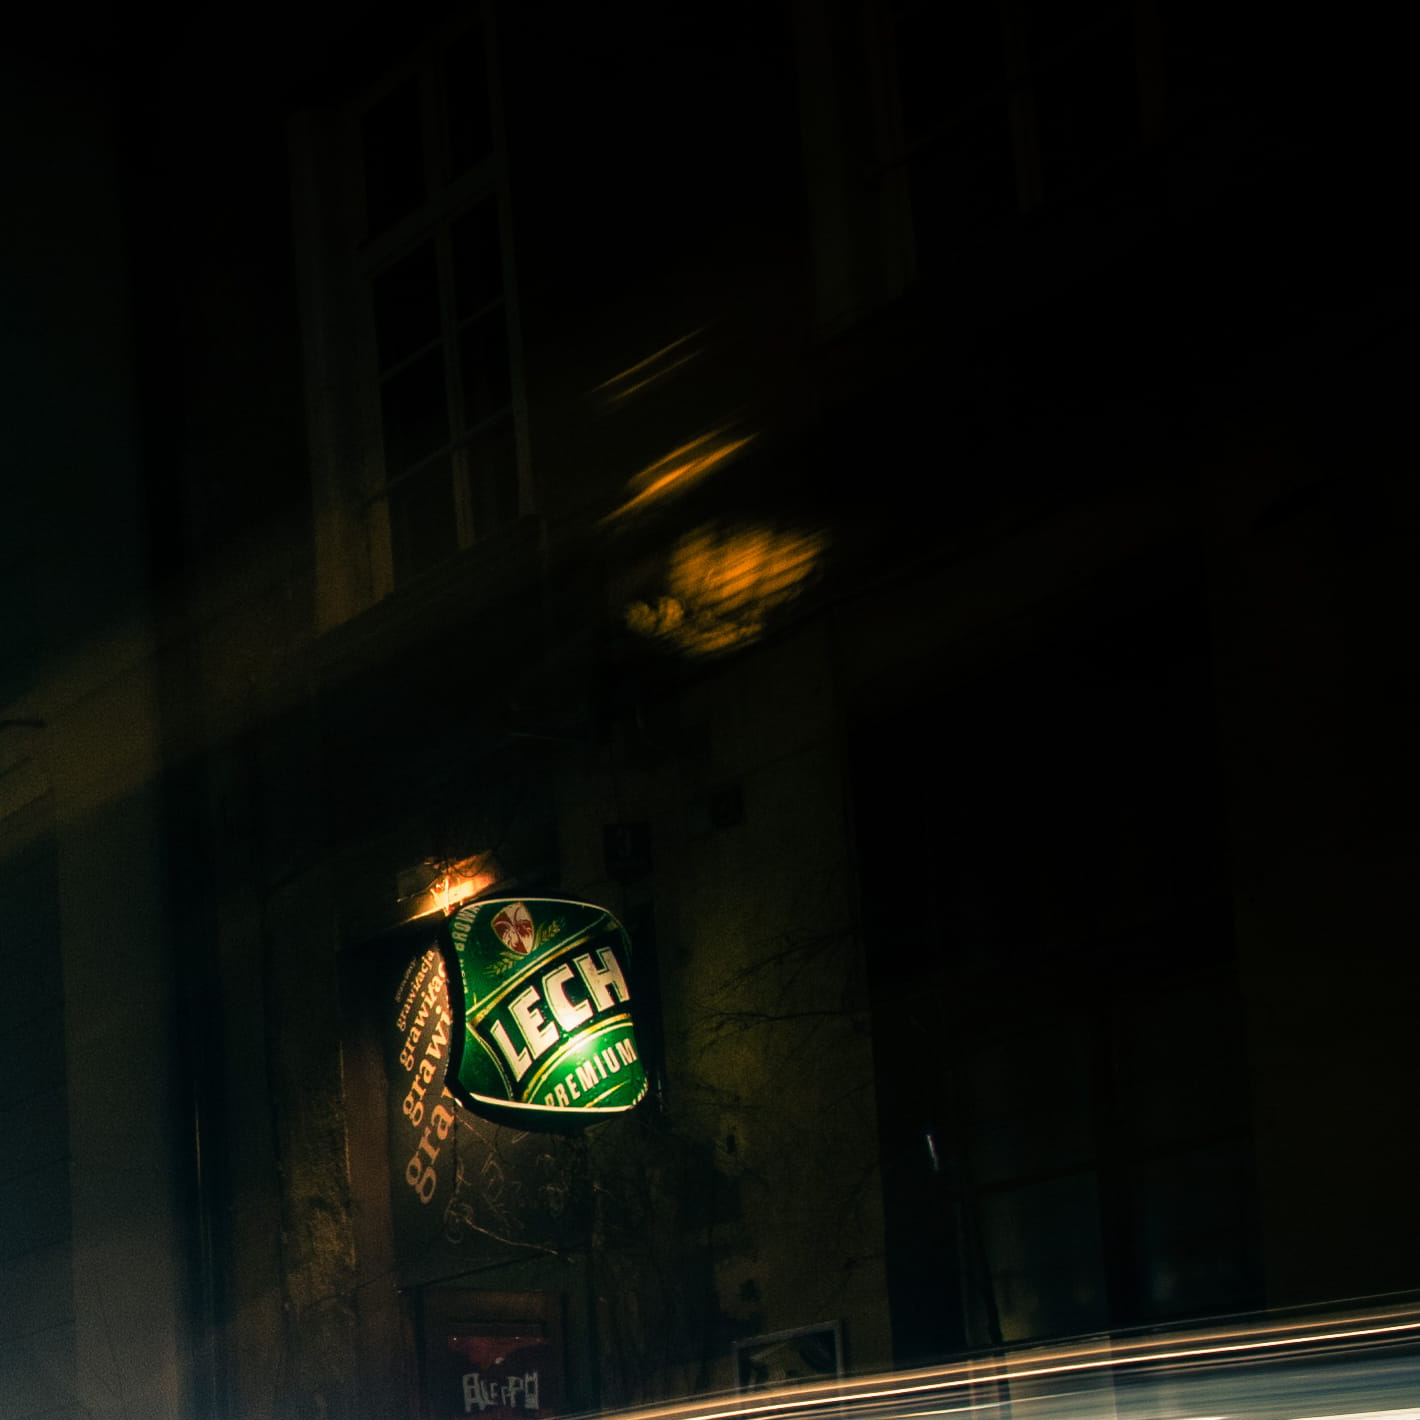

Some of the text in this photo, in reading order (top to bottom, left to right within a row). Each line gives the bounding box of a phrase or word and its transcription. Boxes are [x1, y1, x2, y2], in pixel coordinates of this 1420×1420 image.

[490, 945, 631, 1083] LECH
[544, 1037, 638, 1107] PREMIUM
[405, 1085, 456, 1204] gra
